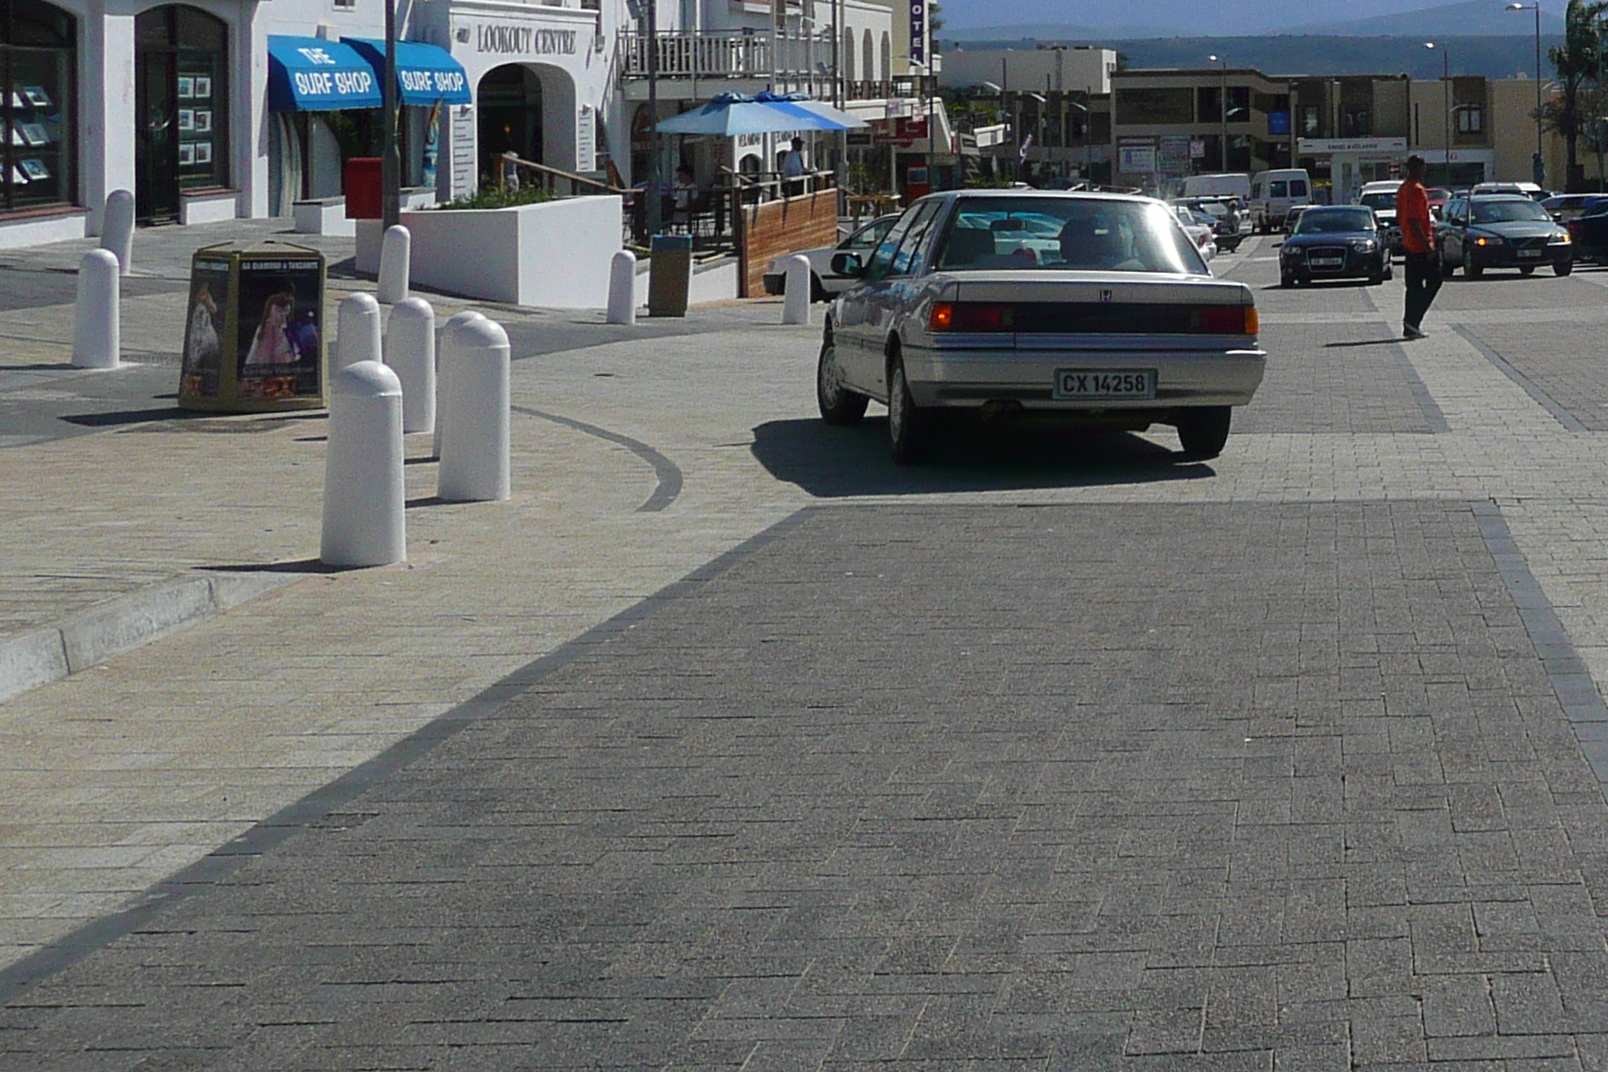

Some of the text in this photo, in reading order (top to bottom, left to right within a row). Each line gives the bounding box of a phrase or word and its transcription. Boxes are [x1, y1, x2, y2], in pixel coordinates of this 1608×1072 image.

[477, 24, 577, 55] LOOKOUT CENTRE
[297, 47, 336, 65] THE
[294, 71, 371, 95] SURF SHOP
[401, 70, 464, 93] SURF SHOP
[1063, 374, 1146, 393] CX 14258
